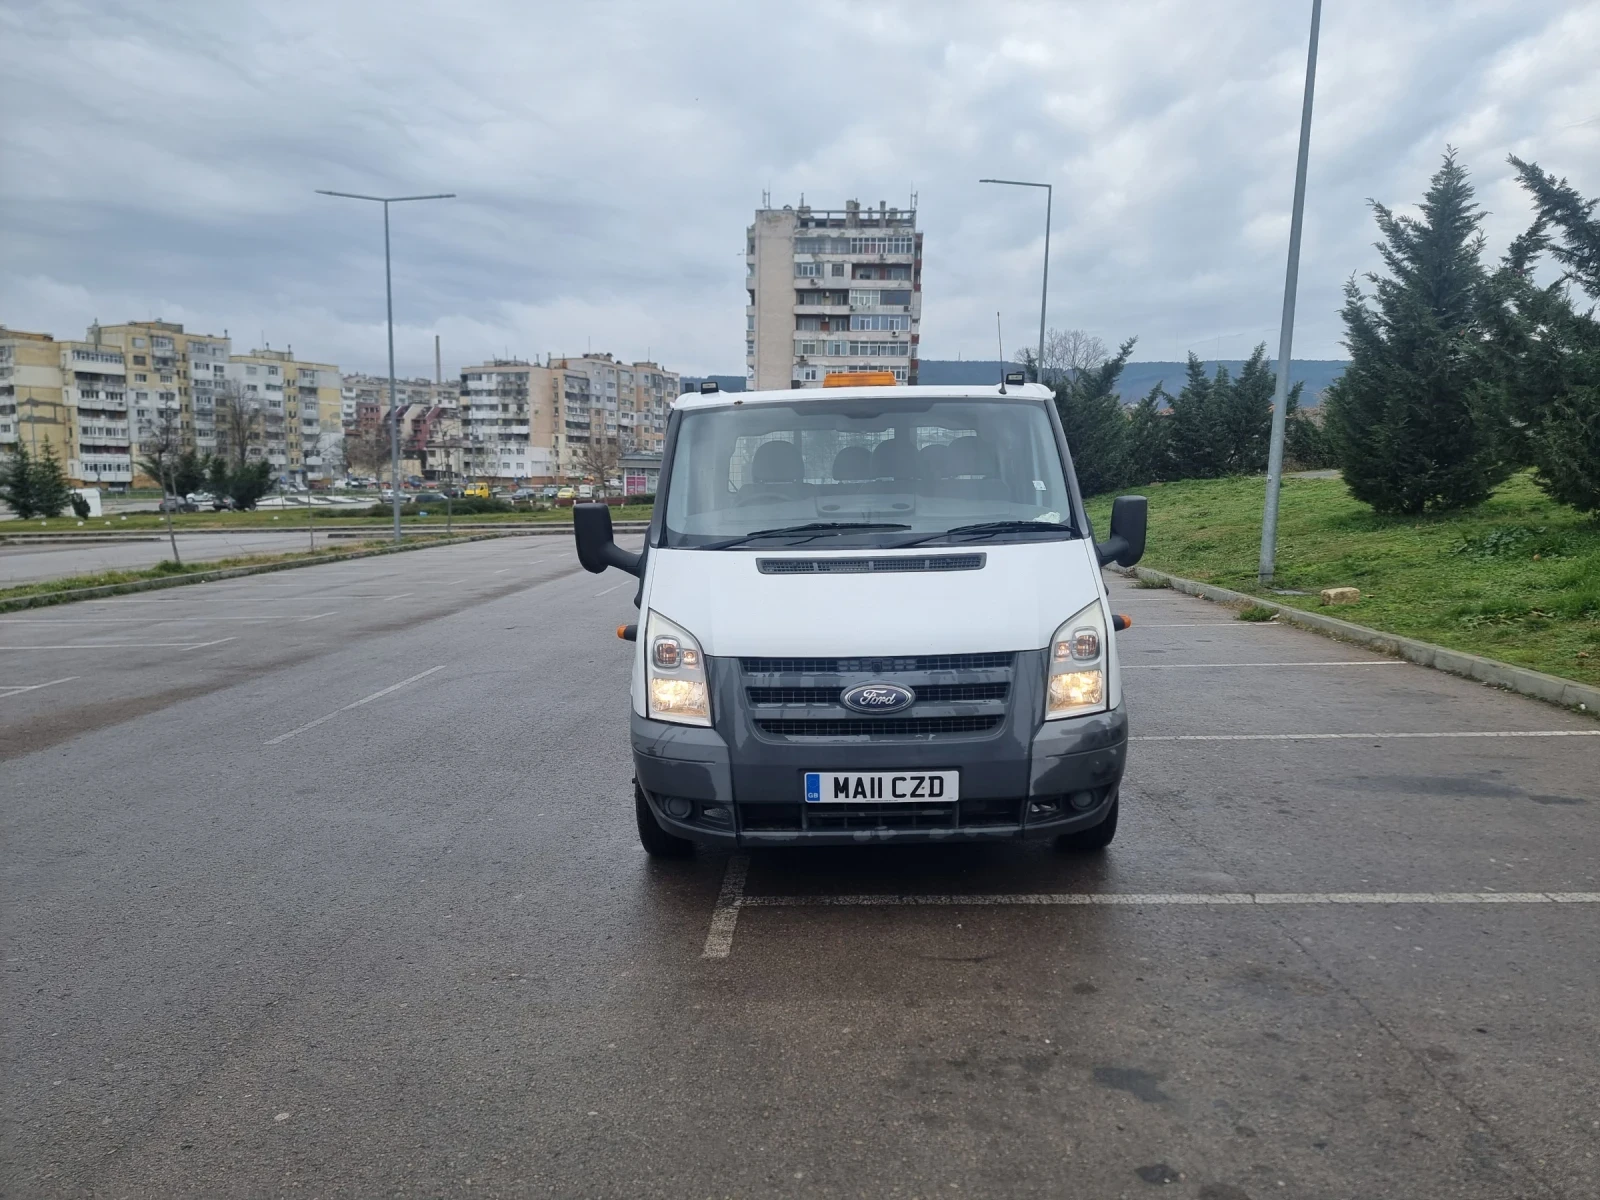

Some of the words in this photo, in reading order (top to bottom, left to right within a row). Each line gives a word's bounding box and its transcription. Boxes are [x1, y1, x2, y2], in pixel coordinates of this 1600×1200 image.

[859, 689, 896, 705] Ford
[833, 776, 883, 799] MA11
[891, 775, 944, 799] CZD
